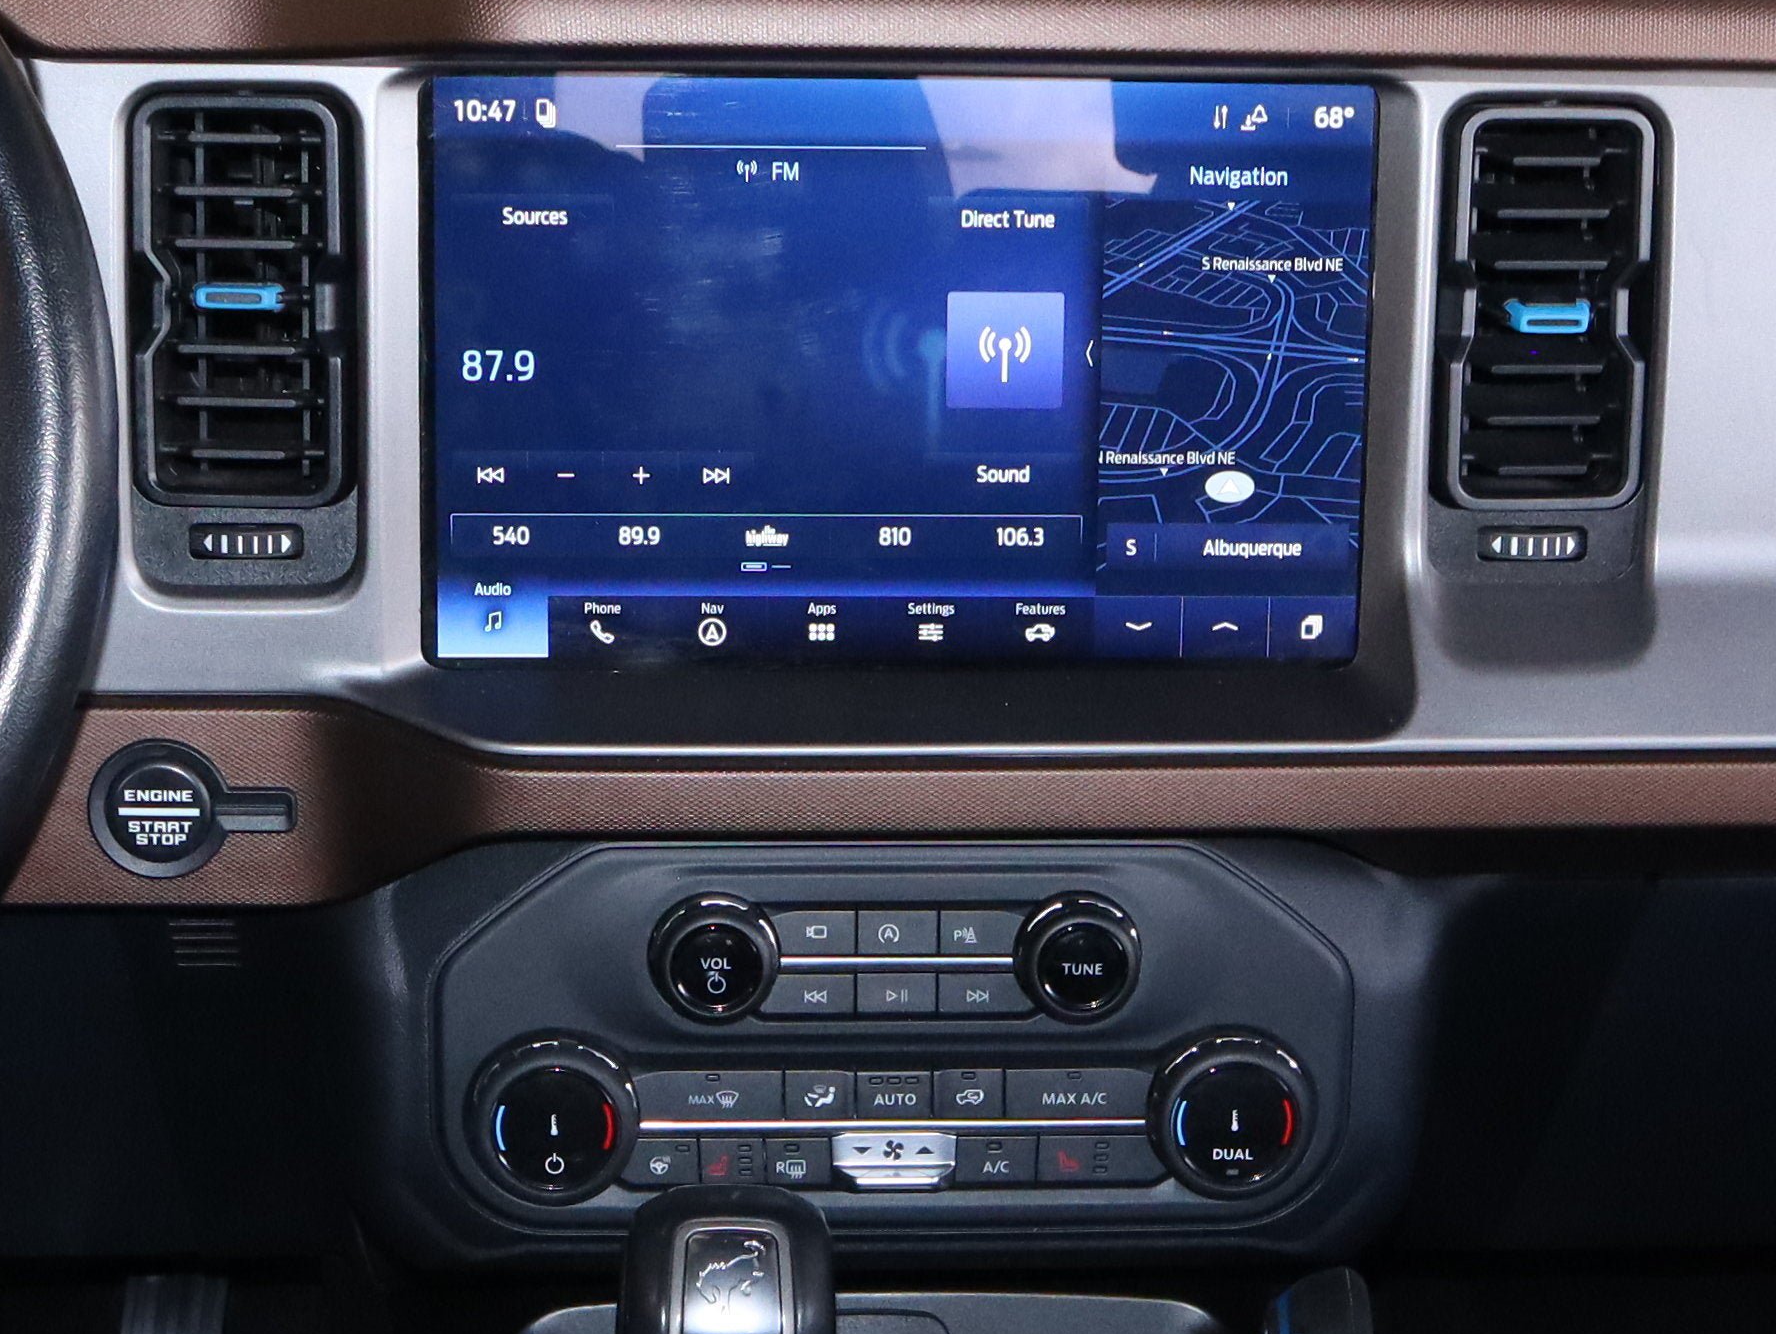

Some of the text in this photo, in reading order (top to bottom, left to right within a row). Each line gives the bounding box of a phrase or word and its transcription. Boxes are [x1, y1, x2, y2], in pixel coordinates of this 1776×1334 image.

[453, 99, 517, 122] 10:47
[1314, 105, 1355, 129] 68°
[772, 161, 800, 181] FM
[1189, 165, 1288, 190] Navigation
[502, 206, 568, 226] Sources
[961, 209, 1056, 229] Direct Tune
[1201, 256, 1347, 272] S Renaissance Blvd NE
[462, 349, 535, 382] 87.9
[1105, 448, 1185, 465] Renaissance
[1186, 450, 1216, 465] Blvd
[1217, 451, 1236, 465] NE
[976, 464, 1031, 483] Sound
[492, 525, 530, 546] 540
[618, 525, 661, 546] 89.9
[878, 526, 912, 547] 810
[996, 526, 1045, 547] 106.3
[1125, 538, 1302, 559] S Albuquerque
[473, 582, 512, 596] Audio
[584, 601, 622, 615] Phone
[701, 602, 725, 615] Nav
[807, 602, 837, 617] Apps
[907, 602, 955, 617] Settings
[1015, 602, 1066, 616] Features
[123, 789, 194, 802] ENGINE
[127, 821, 193, 832] START
[136, 834, 187, 845] STOP
[700, 957, 732, 973] VOL
[1061, 962, 1103, 976] TUNE
[688, 1094, 715, 1105] MAX
[873, 1093, 917, 1106] AUTO
[1042, 1092, 1107, 1106] MAX A/C
[1212, 1148, 1254, 1161] DUAL
[982, 1160, 1010, 1174] A/C
